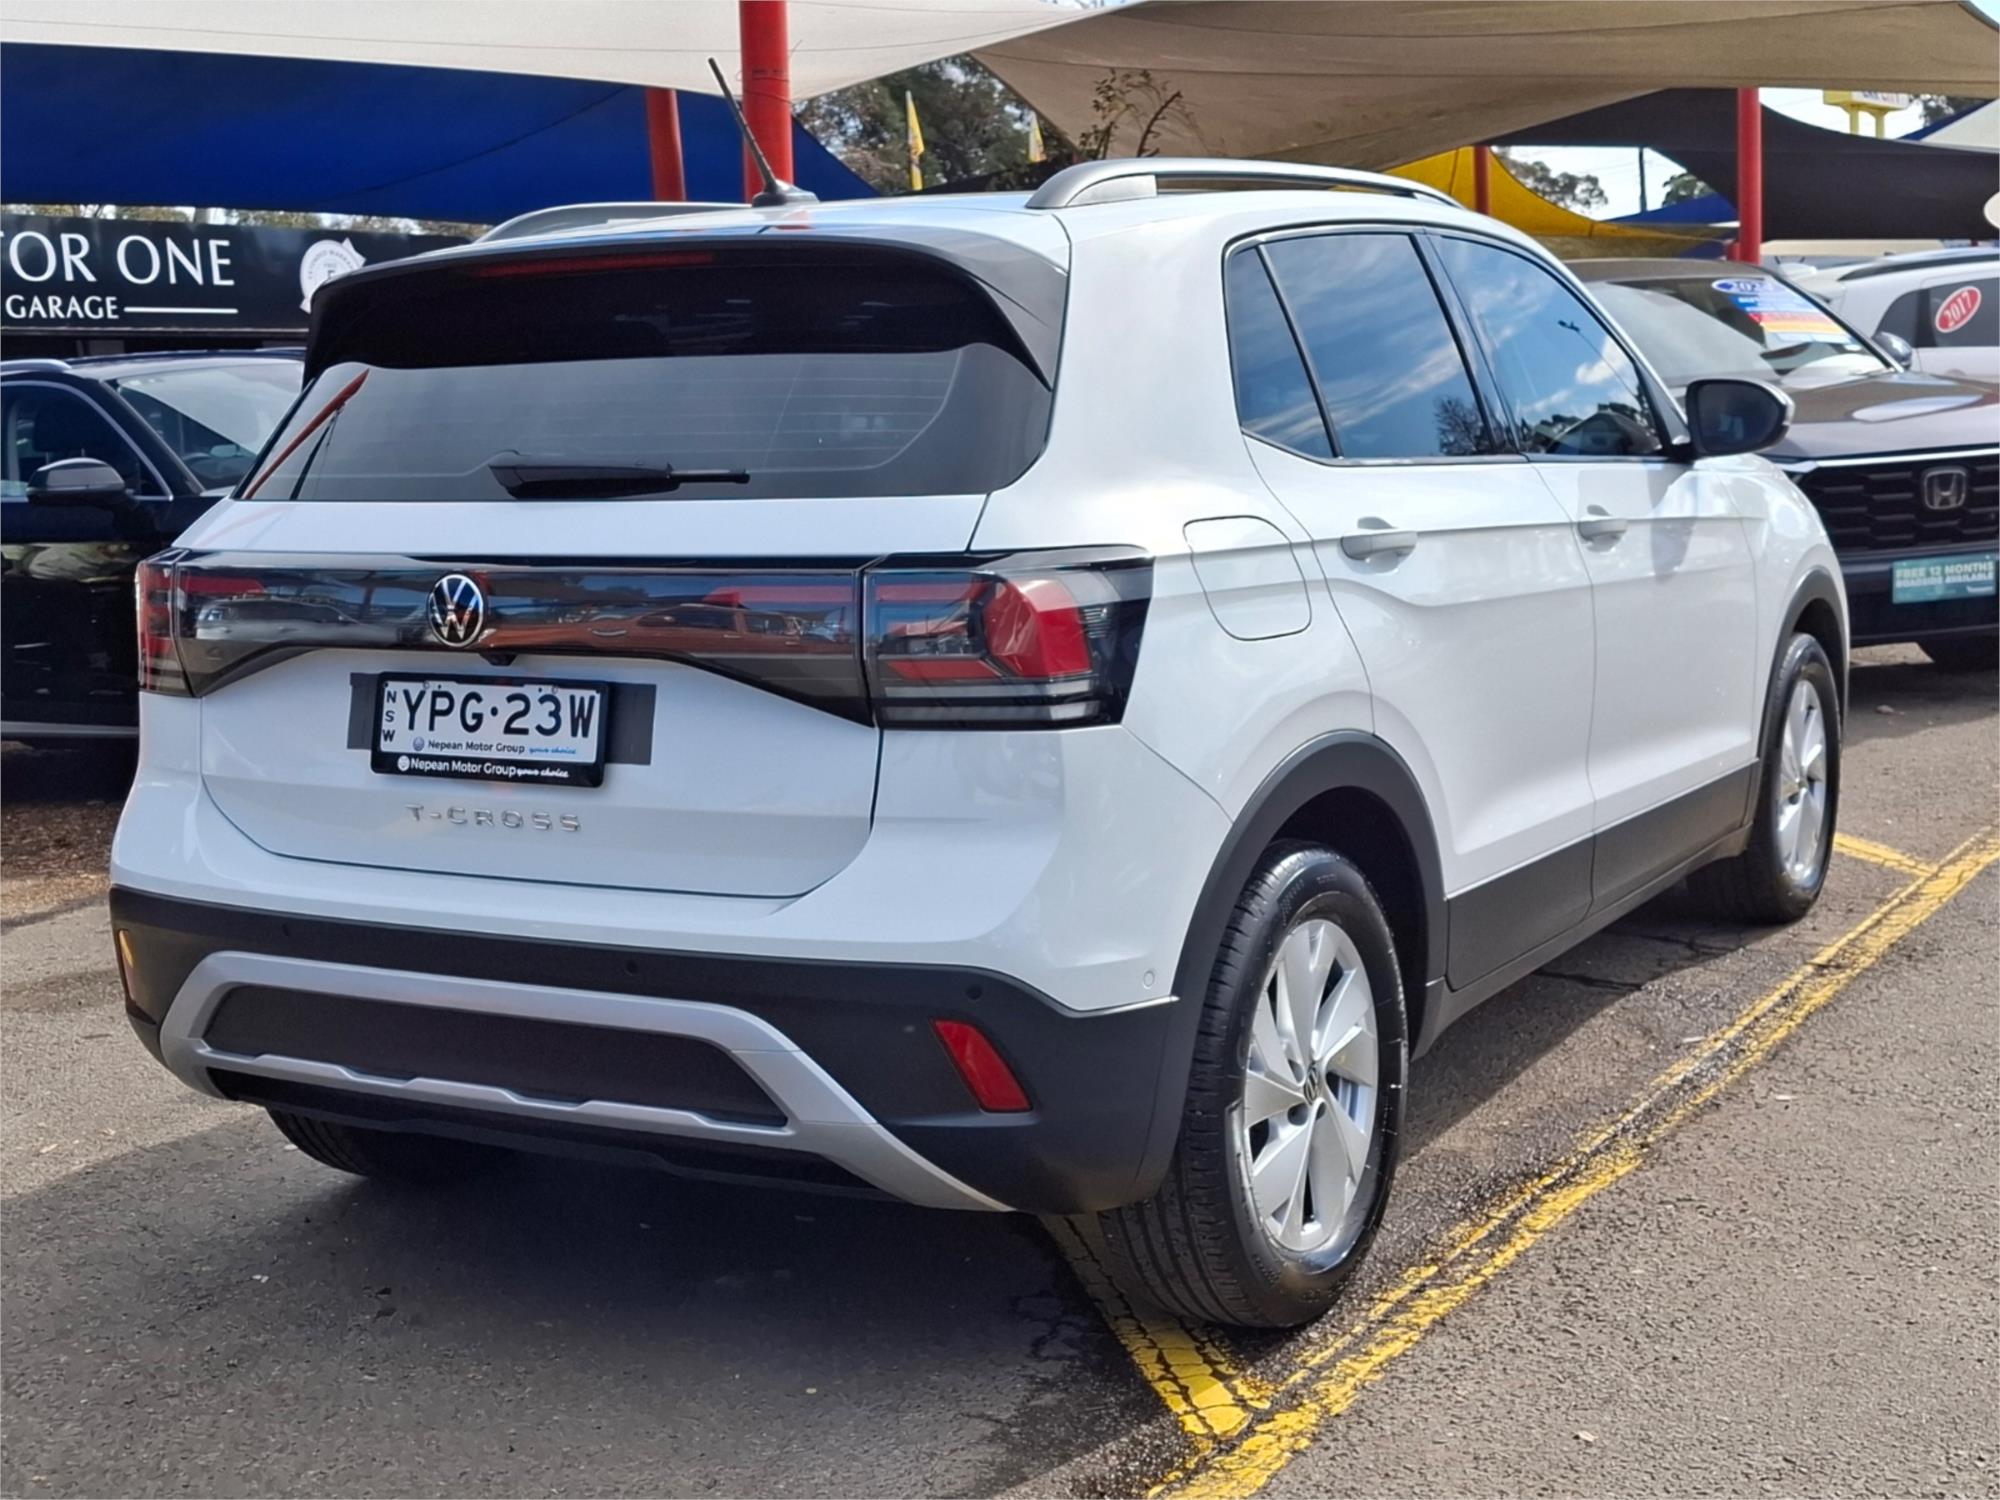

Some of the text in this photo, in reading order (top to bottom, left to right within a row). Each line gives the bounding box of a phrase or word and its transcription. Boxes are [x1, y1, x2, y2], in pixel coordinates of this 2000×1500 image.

[0, 230, 235, 286] OR ONE
[5, 294, 120, 320] GARAGE
[1942, 290, 1972, 328] 2017
[1944, 560, 1994, 575] MONTHS
[428, 740, 463, 752] Nepean
[465, 741, 494, 752] Motor
[495, 743, 525, 754] Group
[410, 757, 450, 772] Nepean
[451, 759, 482, 773] Motor
[483, 763, 517, 777] Group
[405, 804, 582, 832] T-CROSS
